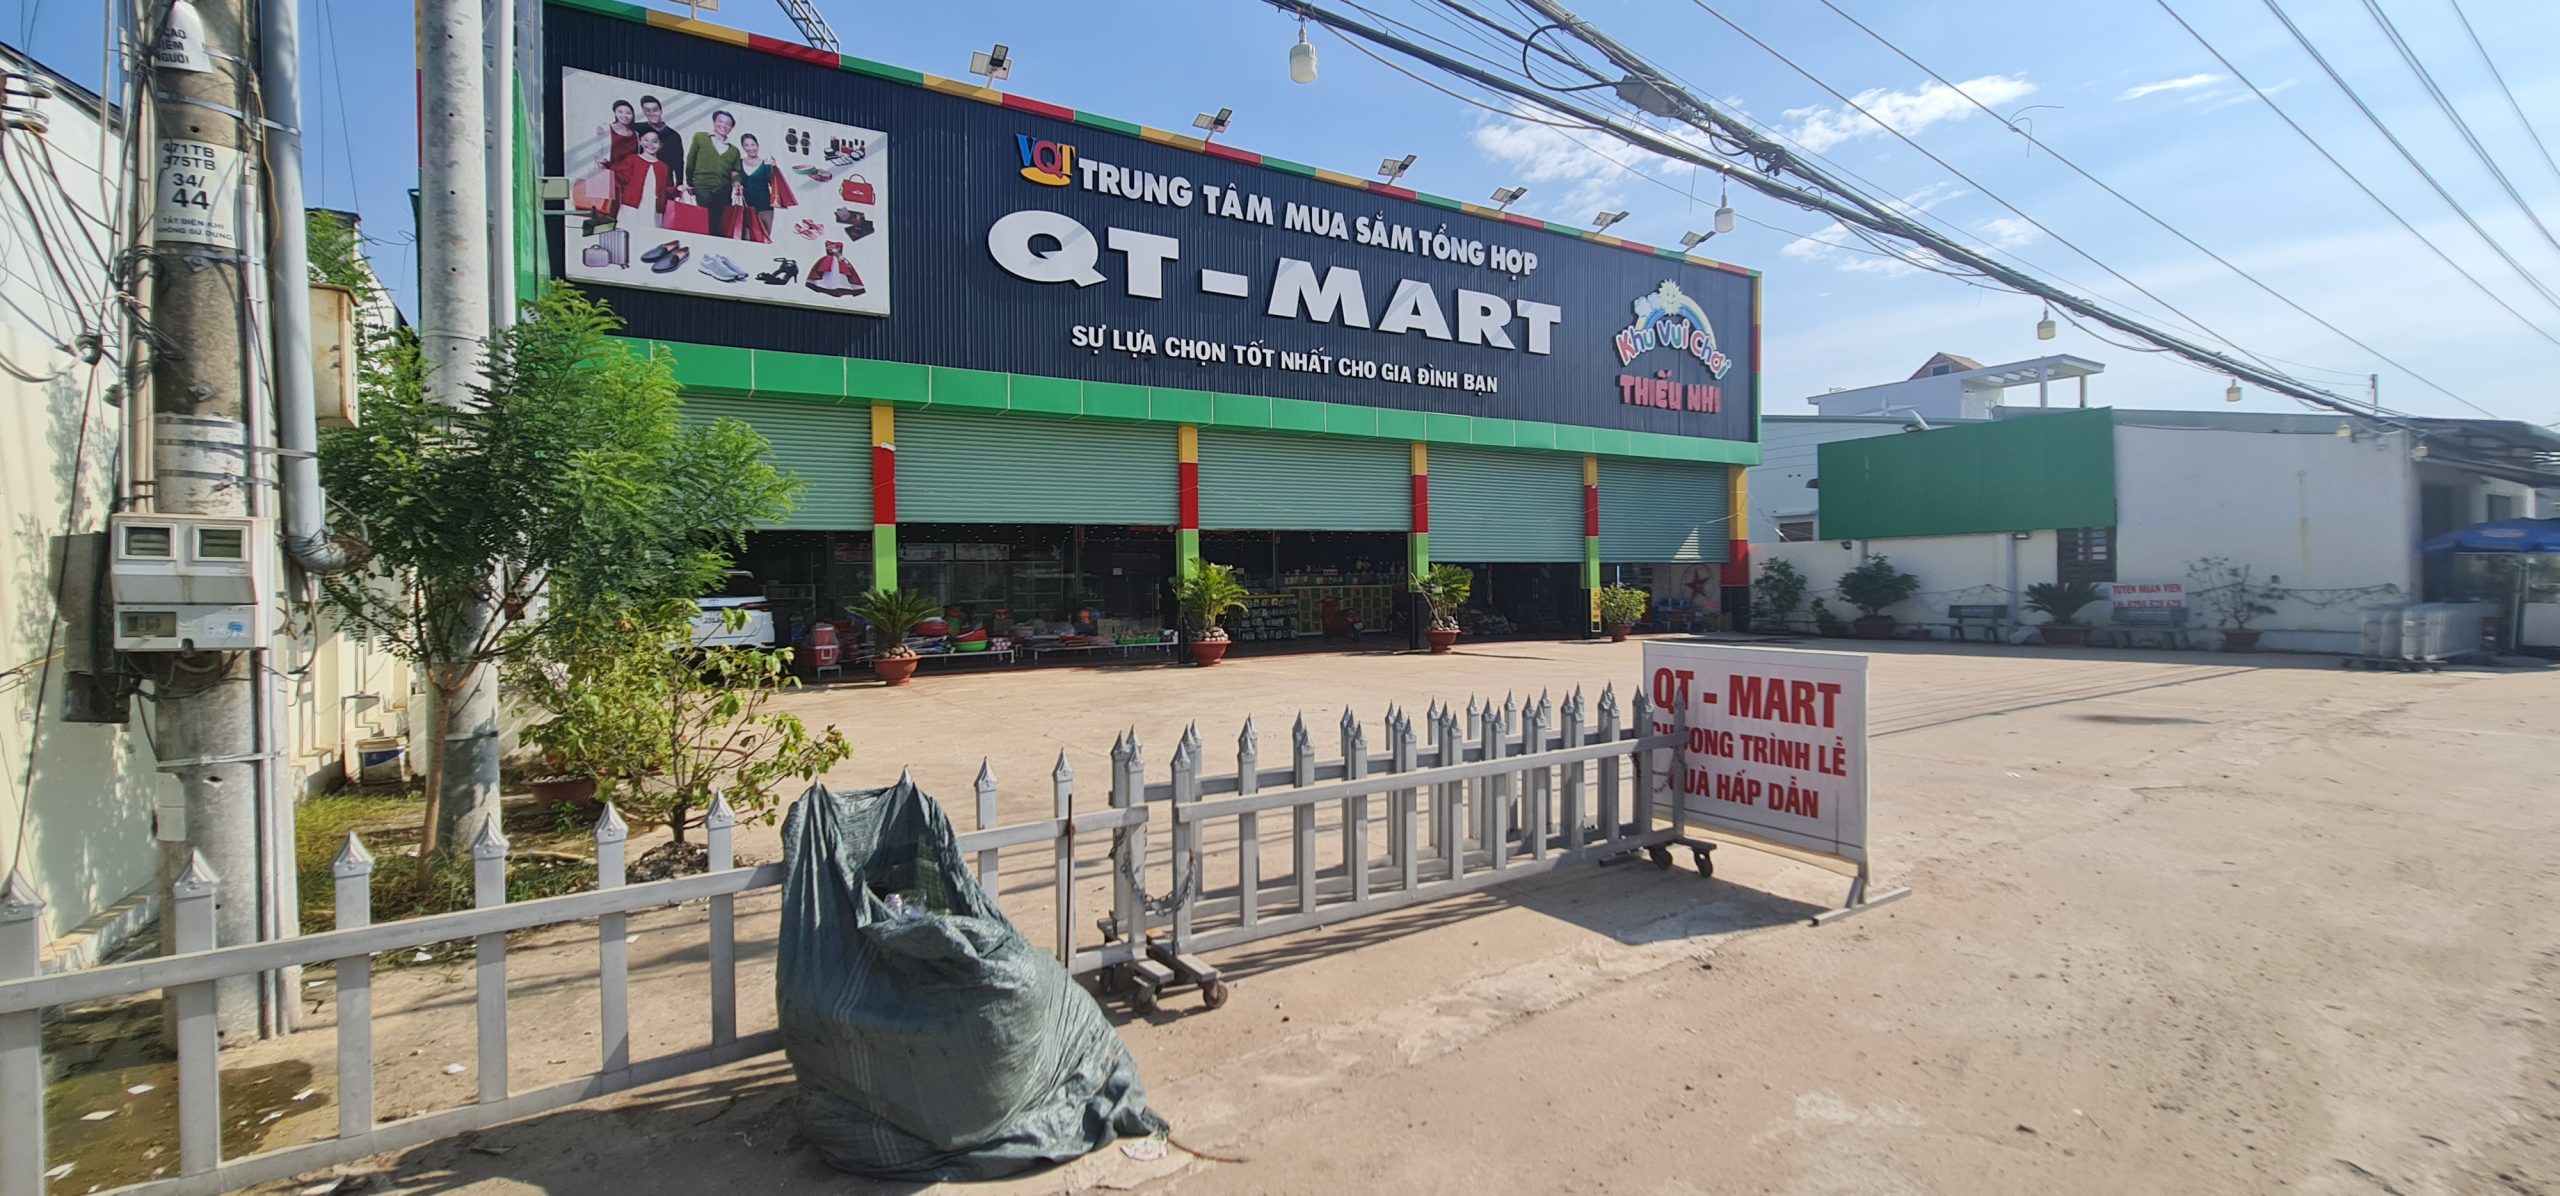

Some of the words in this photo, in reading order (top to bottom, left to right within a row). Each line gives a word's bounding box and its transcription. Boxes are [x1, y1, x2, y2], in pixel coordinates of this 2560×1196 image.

[1015, 133, 1076, 178] VQT
[171, 188, 210, 210] 44
[172, 172, 206, 188] 34/
[1078, 156, 1194, 209] TRUNG
[1203, 182, 1275, 226] TÂM
[1284, 202, 1349, 241] MUA
[1355, 210, 1415, 253] SẮM
[1418, 223, 1486, 267] TỔNG
[1490, 245, 1539, 282] HỢP
[1071, 324, 1107, 355] SỰ
[1112, 328, 1157, 359] LỰA
[1164, 336, 1226, 367] CHỌN
[1233, 339, 1276, 368] TỐT
[1280, 346, 1333, 374] NHẤT
[1338, 357, 1378, 380] CHO
[1381, 362, 1412, 383] GIA
[1417, 363, 1458, 389] ĐÌNH
[1463, 373, 1498, 396] BẠN
[1615, 325, 1656, 367] Khu
[1656, 318, 1690, 350] Vui
[1690, 329, 1732, 380] Chơi
[1619, 369, 1683, 410] THIẾU
[1686, 383, 1722, 413] NHI
[1653, 667, 1694, 714] QT
[1729, 674, 1841, 728] MART
[1740, 732, 1810, 771] TRÌNH
[1669, 765, 1710, 797] UÀ
[1716, 769, 1761, 806] HẤP
